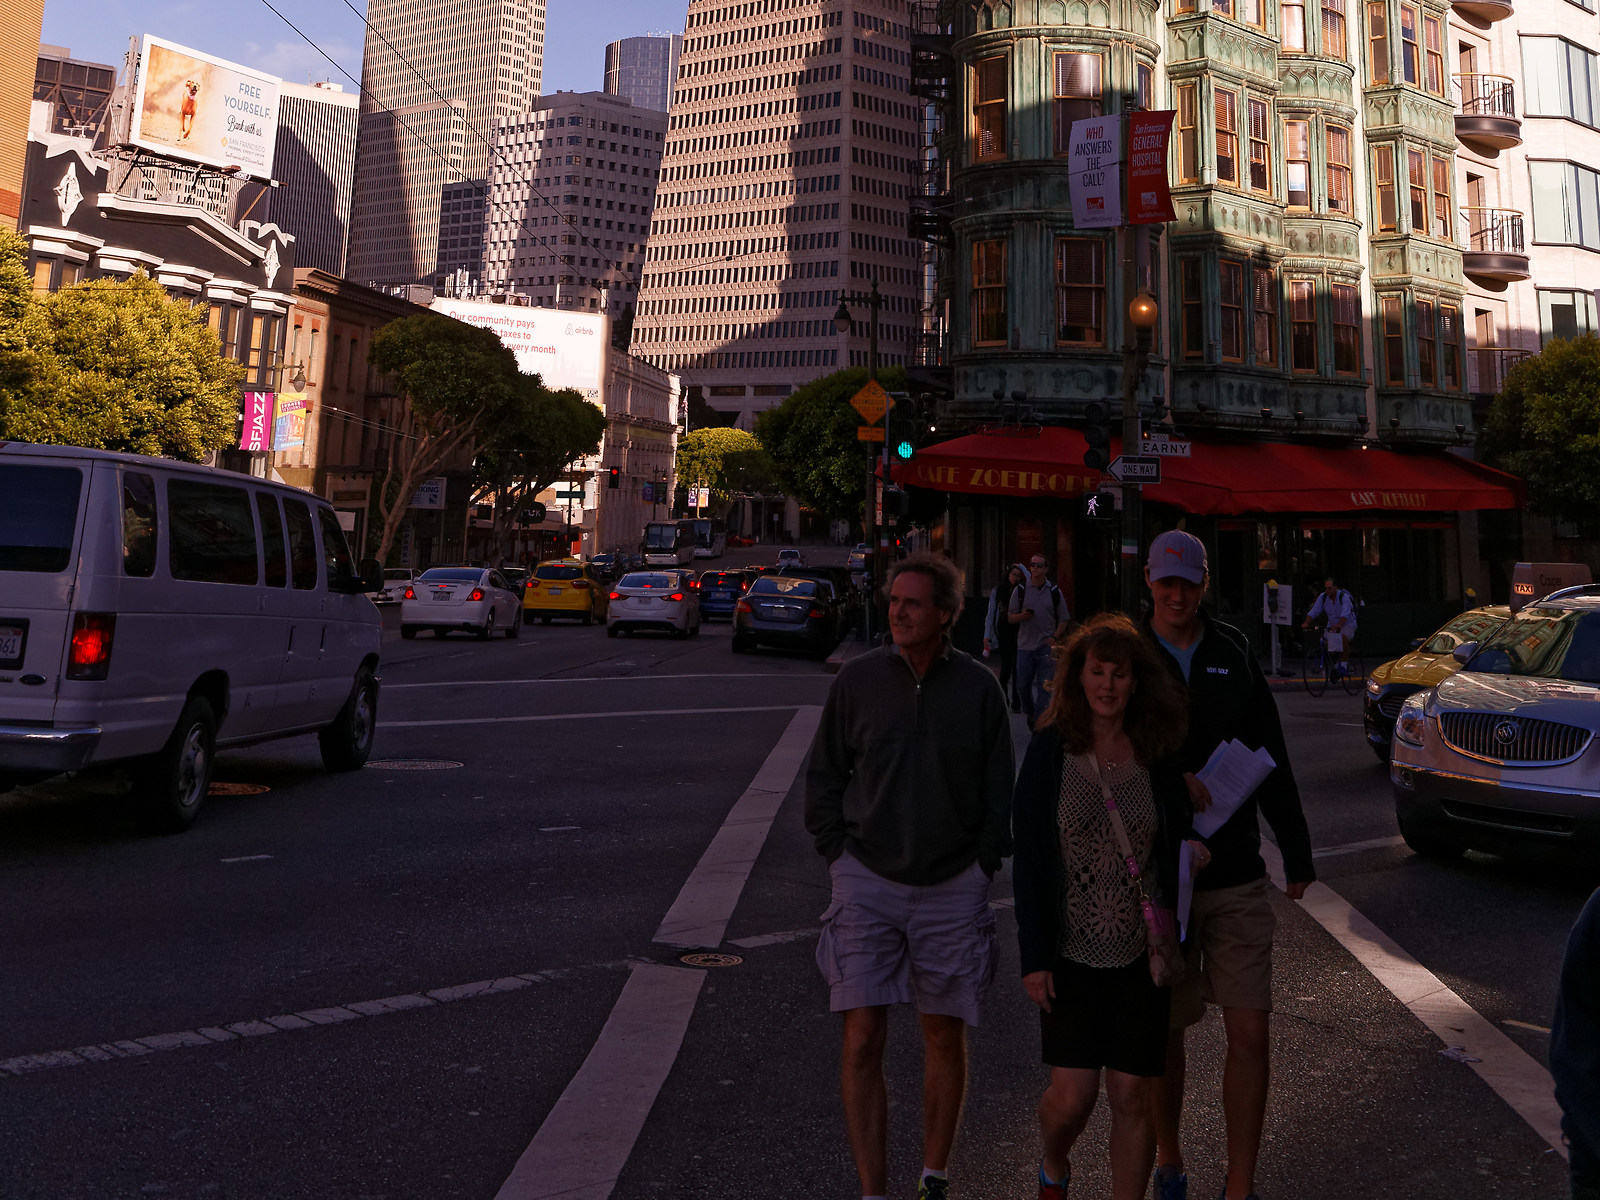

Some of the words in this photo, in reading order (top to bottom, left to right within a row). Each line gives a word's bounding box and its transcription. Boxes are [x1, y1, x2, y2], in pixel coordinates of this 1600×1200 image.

[239, 82, 261, 99] FREE
[224, 95, 272, 120] YOURSELF.
[227, 114, 244, 132] Bank
[244, 123, 256, 135] with
[1135, 124, 1144, 134] San
[1144, 124, 1166, 134] Francisco
[1086, 126, 1104, 140] WHO
[240, 140, 266, 153] FRANCISCO
[1075, 140, 1112, 156] ANSWERS
[1133, 134, 1162, 150] GENERAL
[1086, 156, 1100, 170] THE
[1132, 152, 1162, 168] HOSPITAL
[1082, 172, 1104, 187] CALL?
[450, 311, 466, 320] Our
[468, 314, 514, 328] community
[516, 320, 534, 329] pays
[500, 329, 521, 339] taxes
[574, 326, 594, 336] airbnb
[507, 343, 529, 353] every
[531, 345, 556, 354] month
[248, 392, 265, 451] SFJAZZ
[1143, 443, 1187, 454] EARNY
[1123, 464, 1137, 473] ONE
[1140, 465, 1154, 474] WAY
[916, 464, 960, 484] CAFE
[969, 468, 1097, 492] ZOETROPE
[1351, 492, 1377, 506] CAFE
[1516, 585, 1533, 593] TAXI
